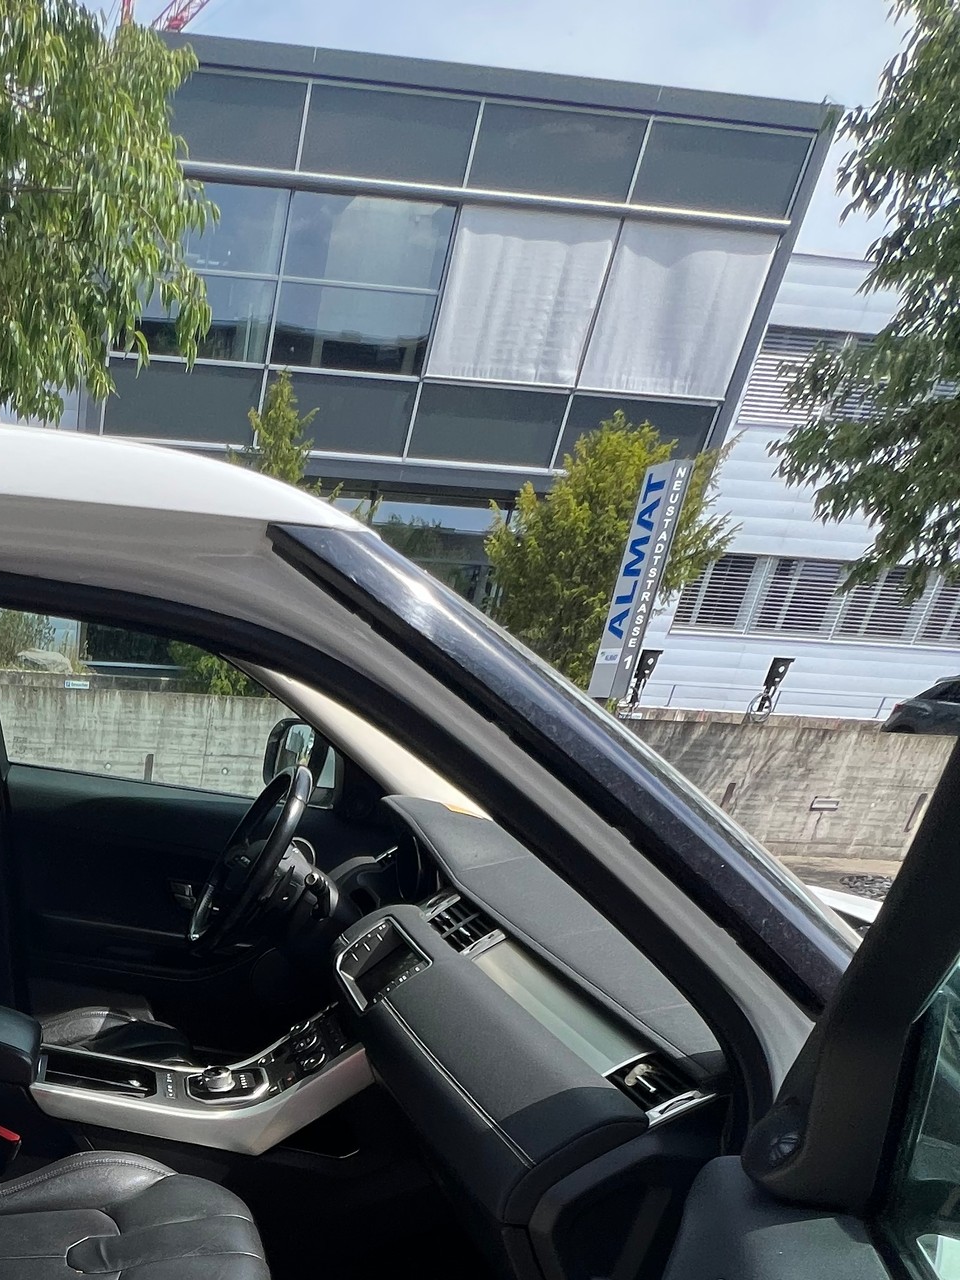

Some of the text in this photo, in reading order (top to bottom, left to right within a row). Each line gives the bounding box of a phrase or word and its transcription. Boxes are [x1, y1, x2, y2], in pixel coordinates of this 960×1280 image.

[608, 473, 666, 640] ALMAT
[623, 466, 687, 670] NEUSTADTSTRASSE 1
